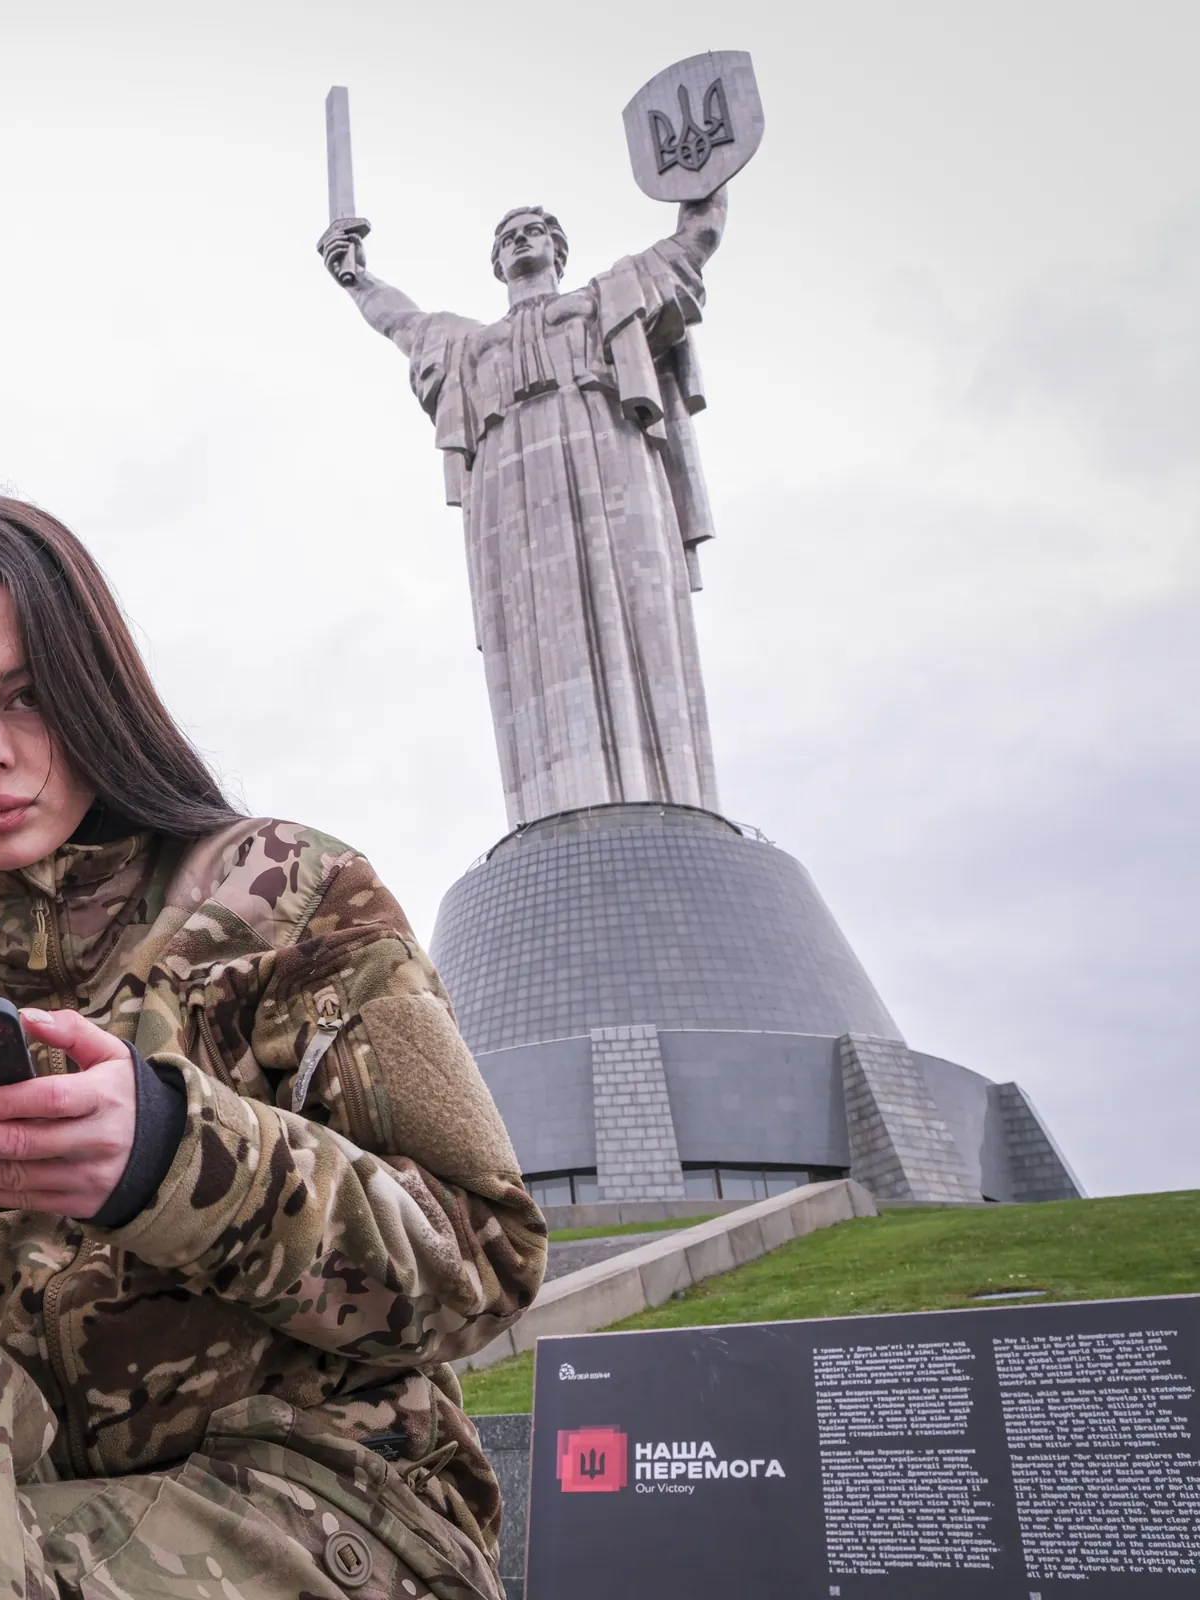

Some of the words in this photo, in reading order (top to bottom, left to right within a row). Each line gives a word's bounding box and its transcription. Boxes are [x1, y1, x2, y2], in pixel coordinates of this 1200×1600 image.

[1135, 1358, 1171, 1366] achieved
[1108, 1374, 1147, 1382] different
[1050, 1411, 1075, 1419] fought
[1079, 1410, 1110, 1419] against
[636, 1441, 716, 1460] НАША
[1096, 1453, 1132, 1461] Victory"
[1136, 1452, 1172, 1460] explores
[1011, 1461, 1054, 1470] importance
[1133, 1460, 1169, 1468] people's
[636, 1459, 786, 1480] ПЕРЕМОГА
[1154, 1476, 1182, 1484] during
[636, 1483, 655, 1493] Our
[657, 1483, 694, 1495] Victory
[1042, 1492, 1068, 1500] shaped
[1034, 1500, 1065, 1508] putin's
[1018, 1507, 1053, 1516] European
[1107, 1516, 1126, 1524] past
[1068, 1524, 1118, 1532] acknowledge
[1141, 1524, 1188, 1532] importance
[1023, 1547, 1063, 1555] practices
[1138, 1557, 1175, 1565] fighting
